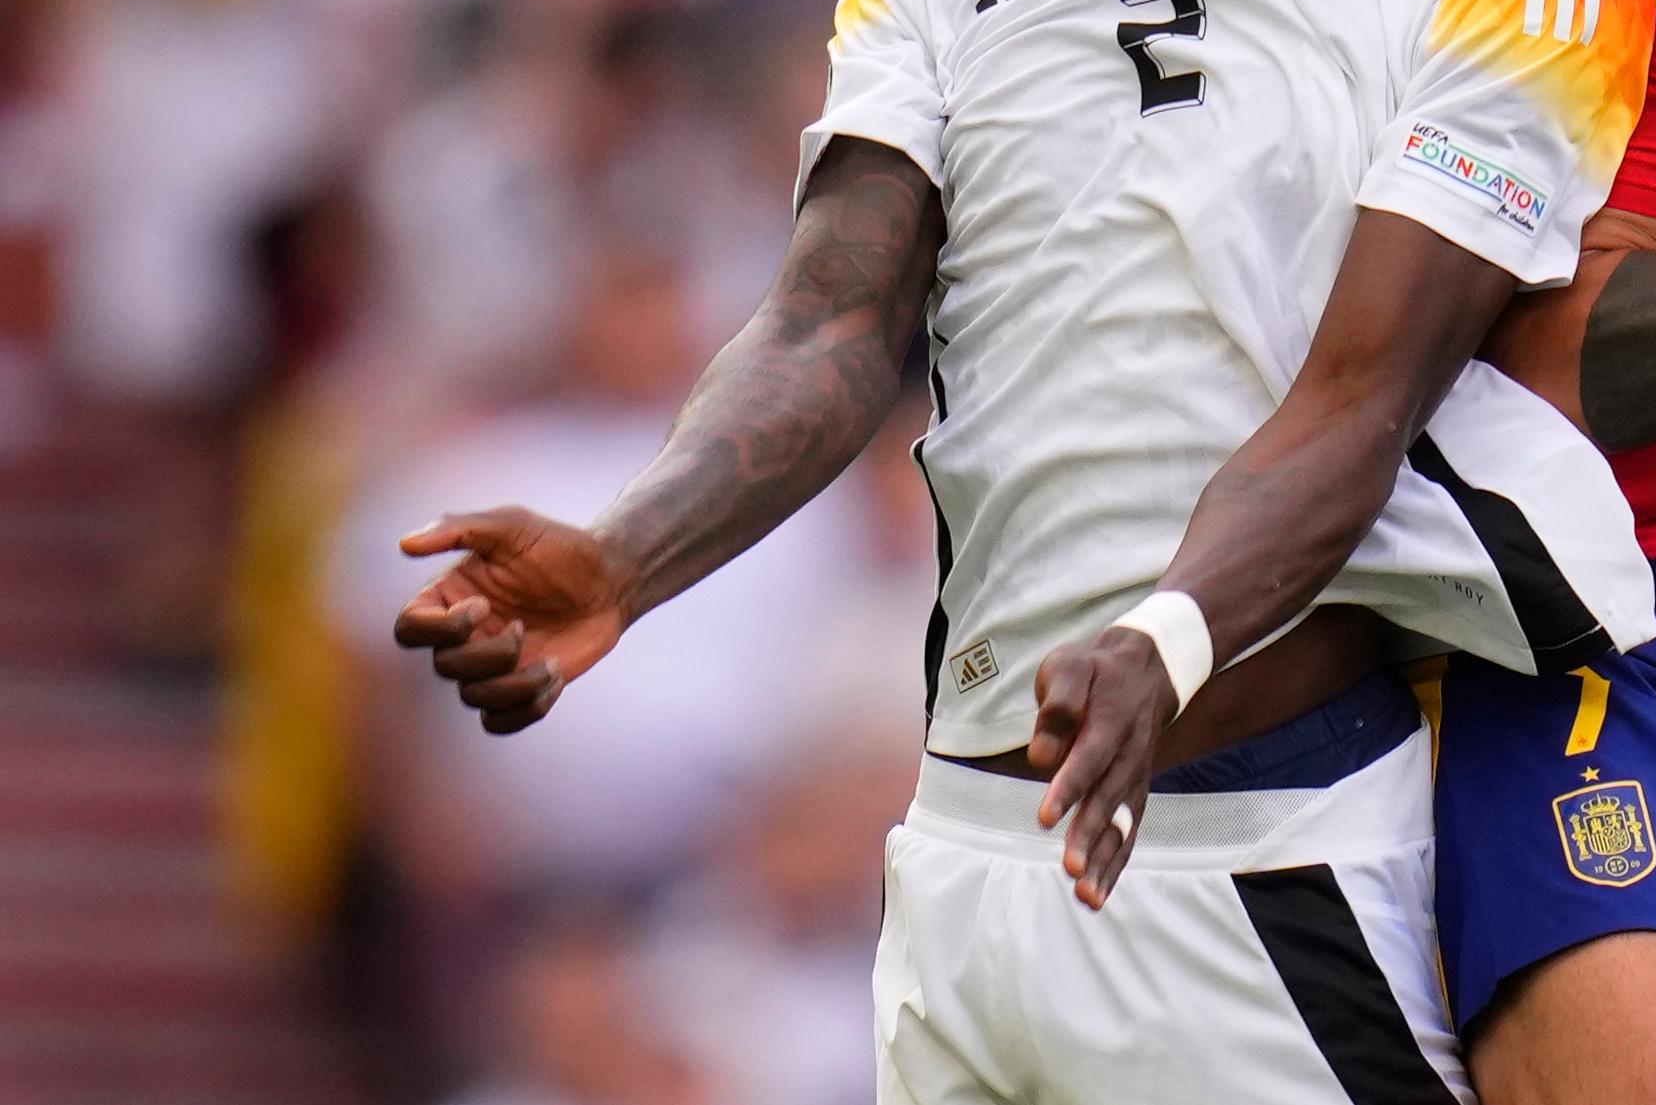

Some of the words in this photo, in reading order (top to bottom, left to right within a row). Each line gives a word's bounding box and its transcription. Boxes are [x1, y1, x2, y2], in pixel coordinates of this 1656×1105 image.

[1413, 122, 1449, 145] UEFA
[1405, 134, 1545, 219] FOUNDATION
[1509, 212, 1535, 232] children
